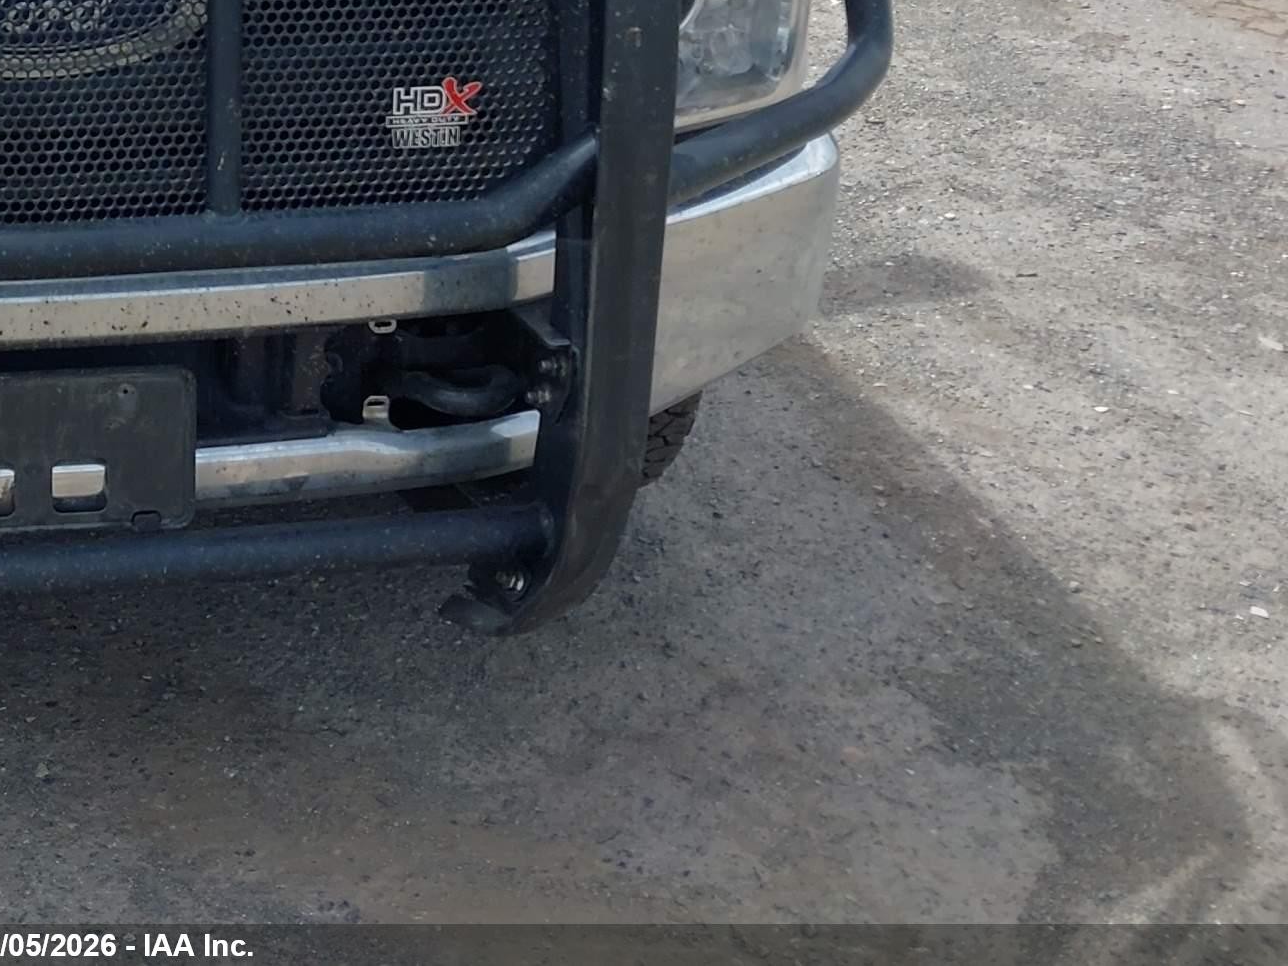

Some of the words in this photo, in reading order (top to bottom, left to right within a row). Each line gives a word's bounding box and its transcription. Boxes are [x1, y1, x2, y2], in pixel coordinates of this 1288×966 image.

[393, 76, 483, 116] HDX
[392, 116, 428, 125] HEAVY
[431, 115, 460, 124] DUTY
